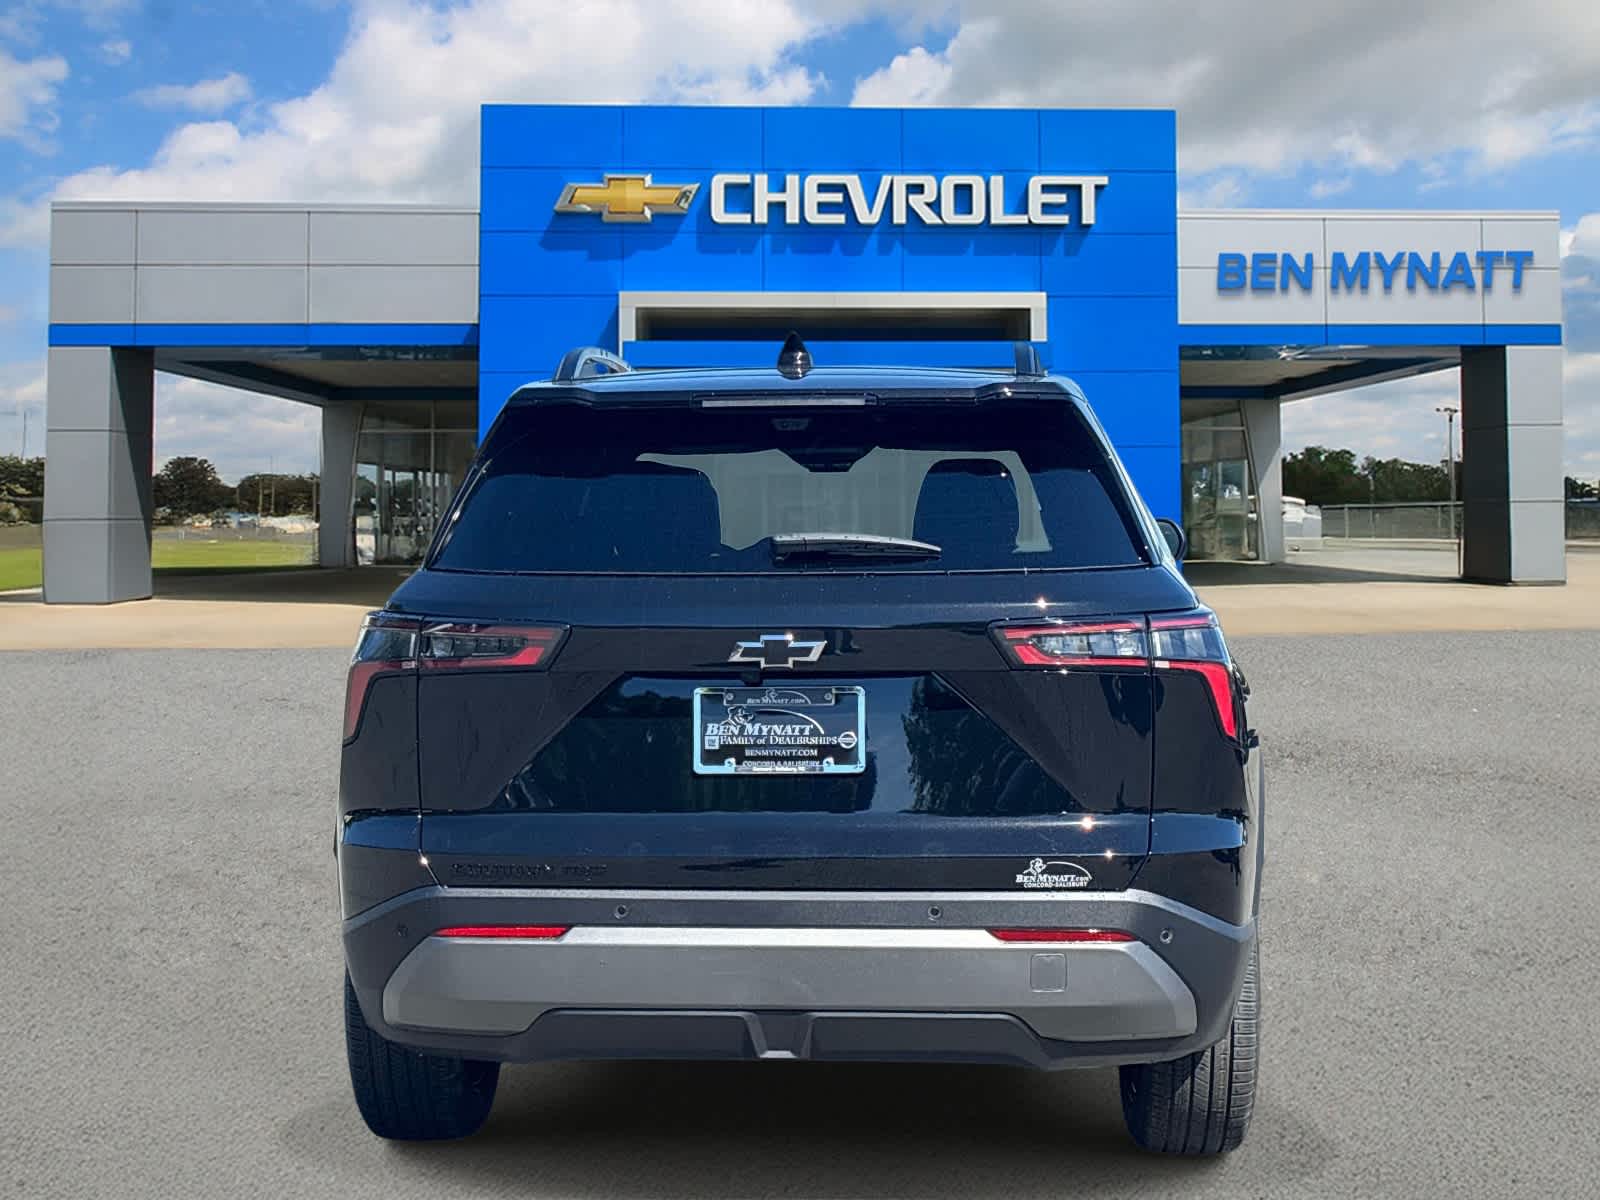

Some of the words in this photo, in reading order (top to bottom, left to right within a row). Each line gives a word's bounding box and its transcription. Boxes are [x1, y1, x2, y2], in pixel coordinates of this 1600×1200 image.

[710, 173, 1109, 225] CHEVROLET
[1217, 252, 1313, 290] BEN
[1331, 251, 1534, 290] MYNATT
[705, 723, 740, 735] BEN
[743, 723, 814, 735] MYNATT
[720, 735, 755, 745] FAMILY
[756, 736, 767, 745] of
[769, 735, 838, 745] DEALERSHIPS
[744, 749, 818, 757] BENMYNATT.COM
[1015, 874, 1035, 882] BEN
